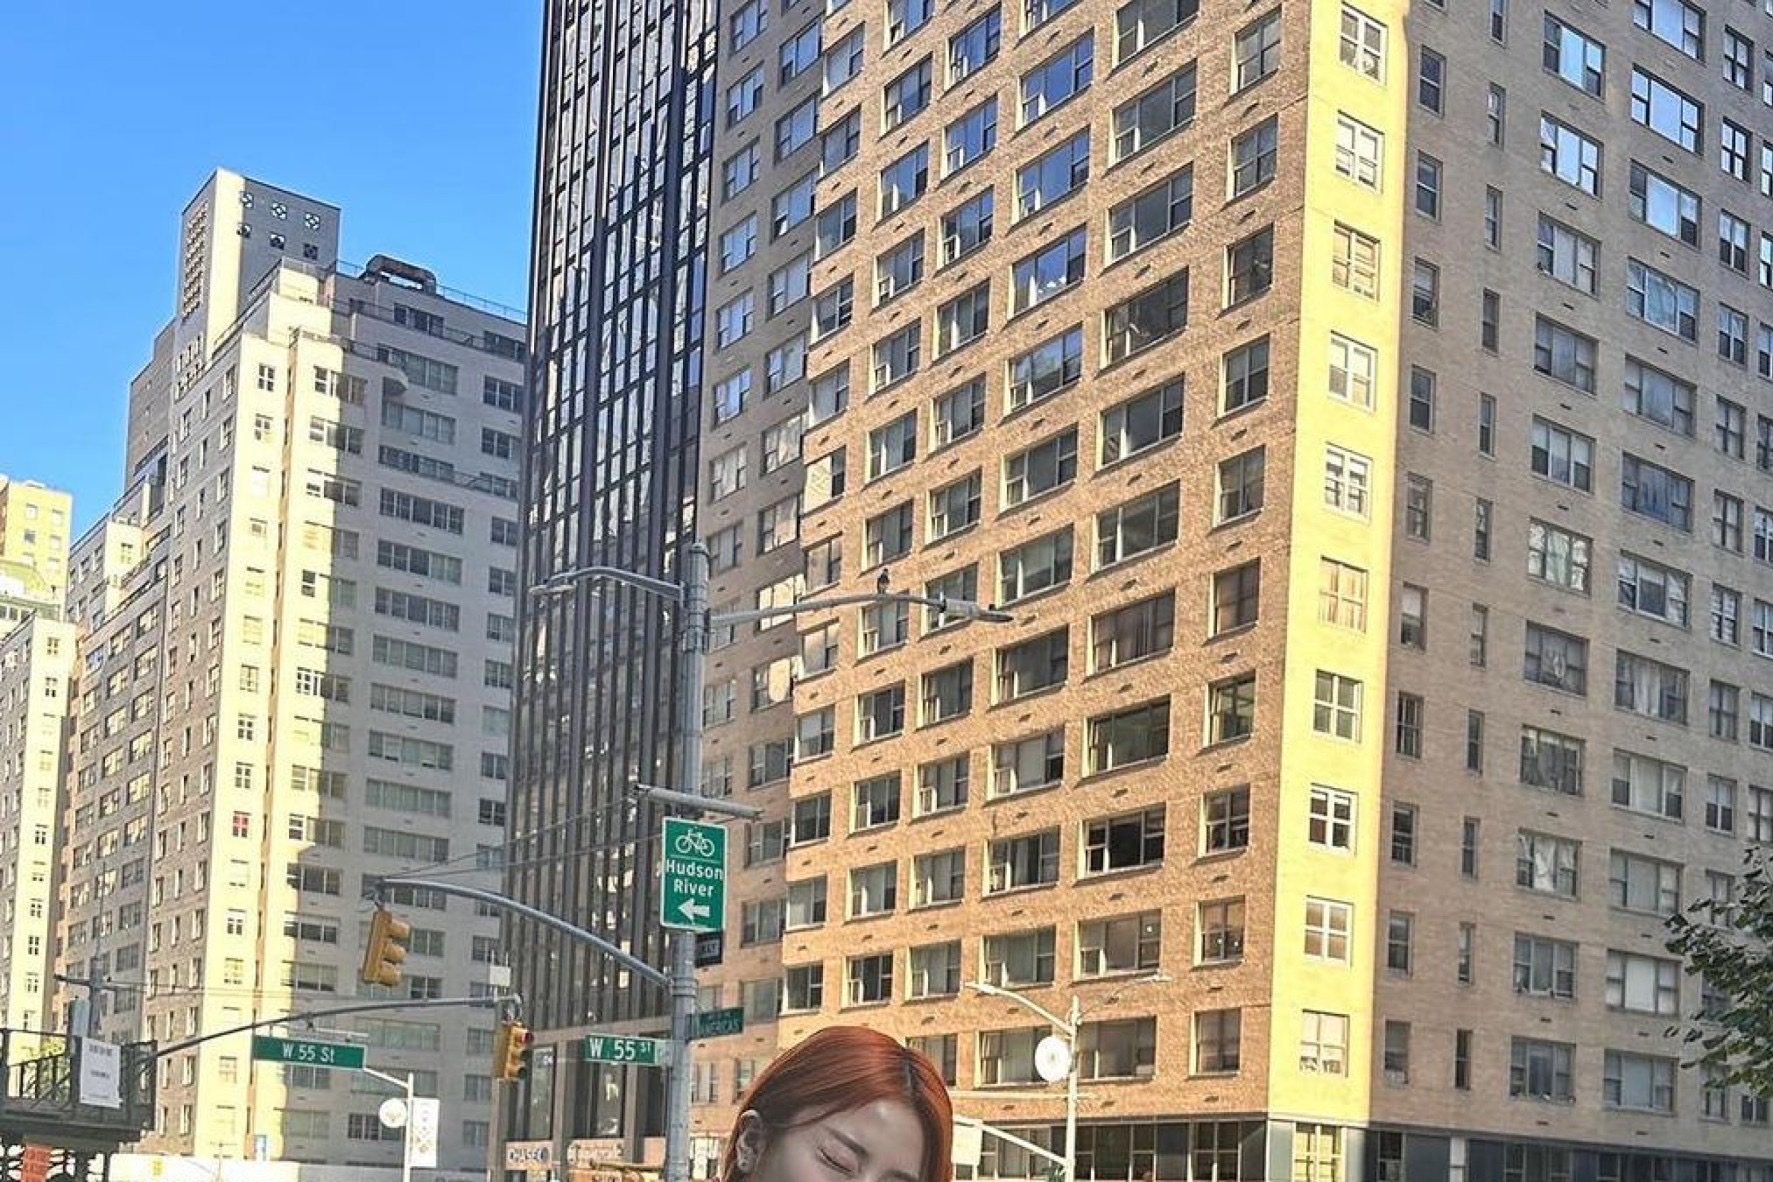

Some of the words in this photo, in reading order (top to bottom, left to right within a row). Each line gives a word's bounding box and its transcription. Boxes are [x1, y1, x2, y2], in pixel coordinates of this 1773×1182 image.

[666, 860, 724, 880] Hudson
[673, 878, 714, 897] River
[282, 1042, 294, 1059] W
[298, 1044, 316, 1061] 55
[320, 1046, 335, 1063] St
[589, 1036, 603, 1059] W
[614, 1039, 636, 1060] 55
